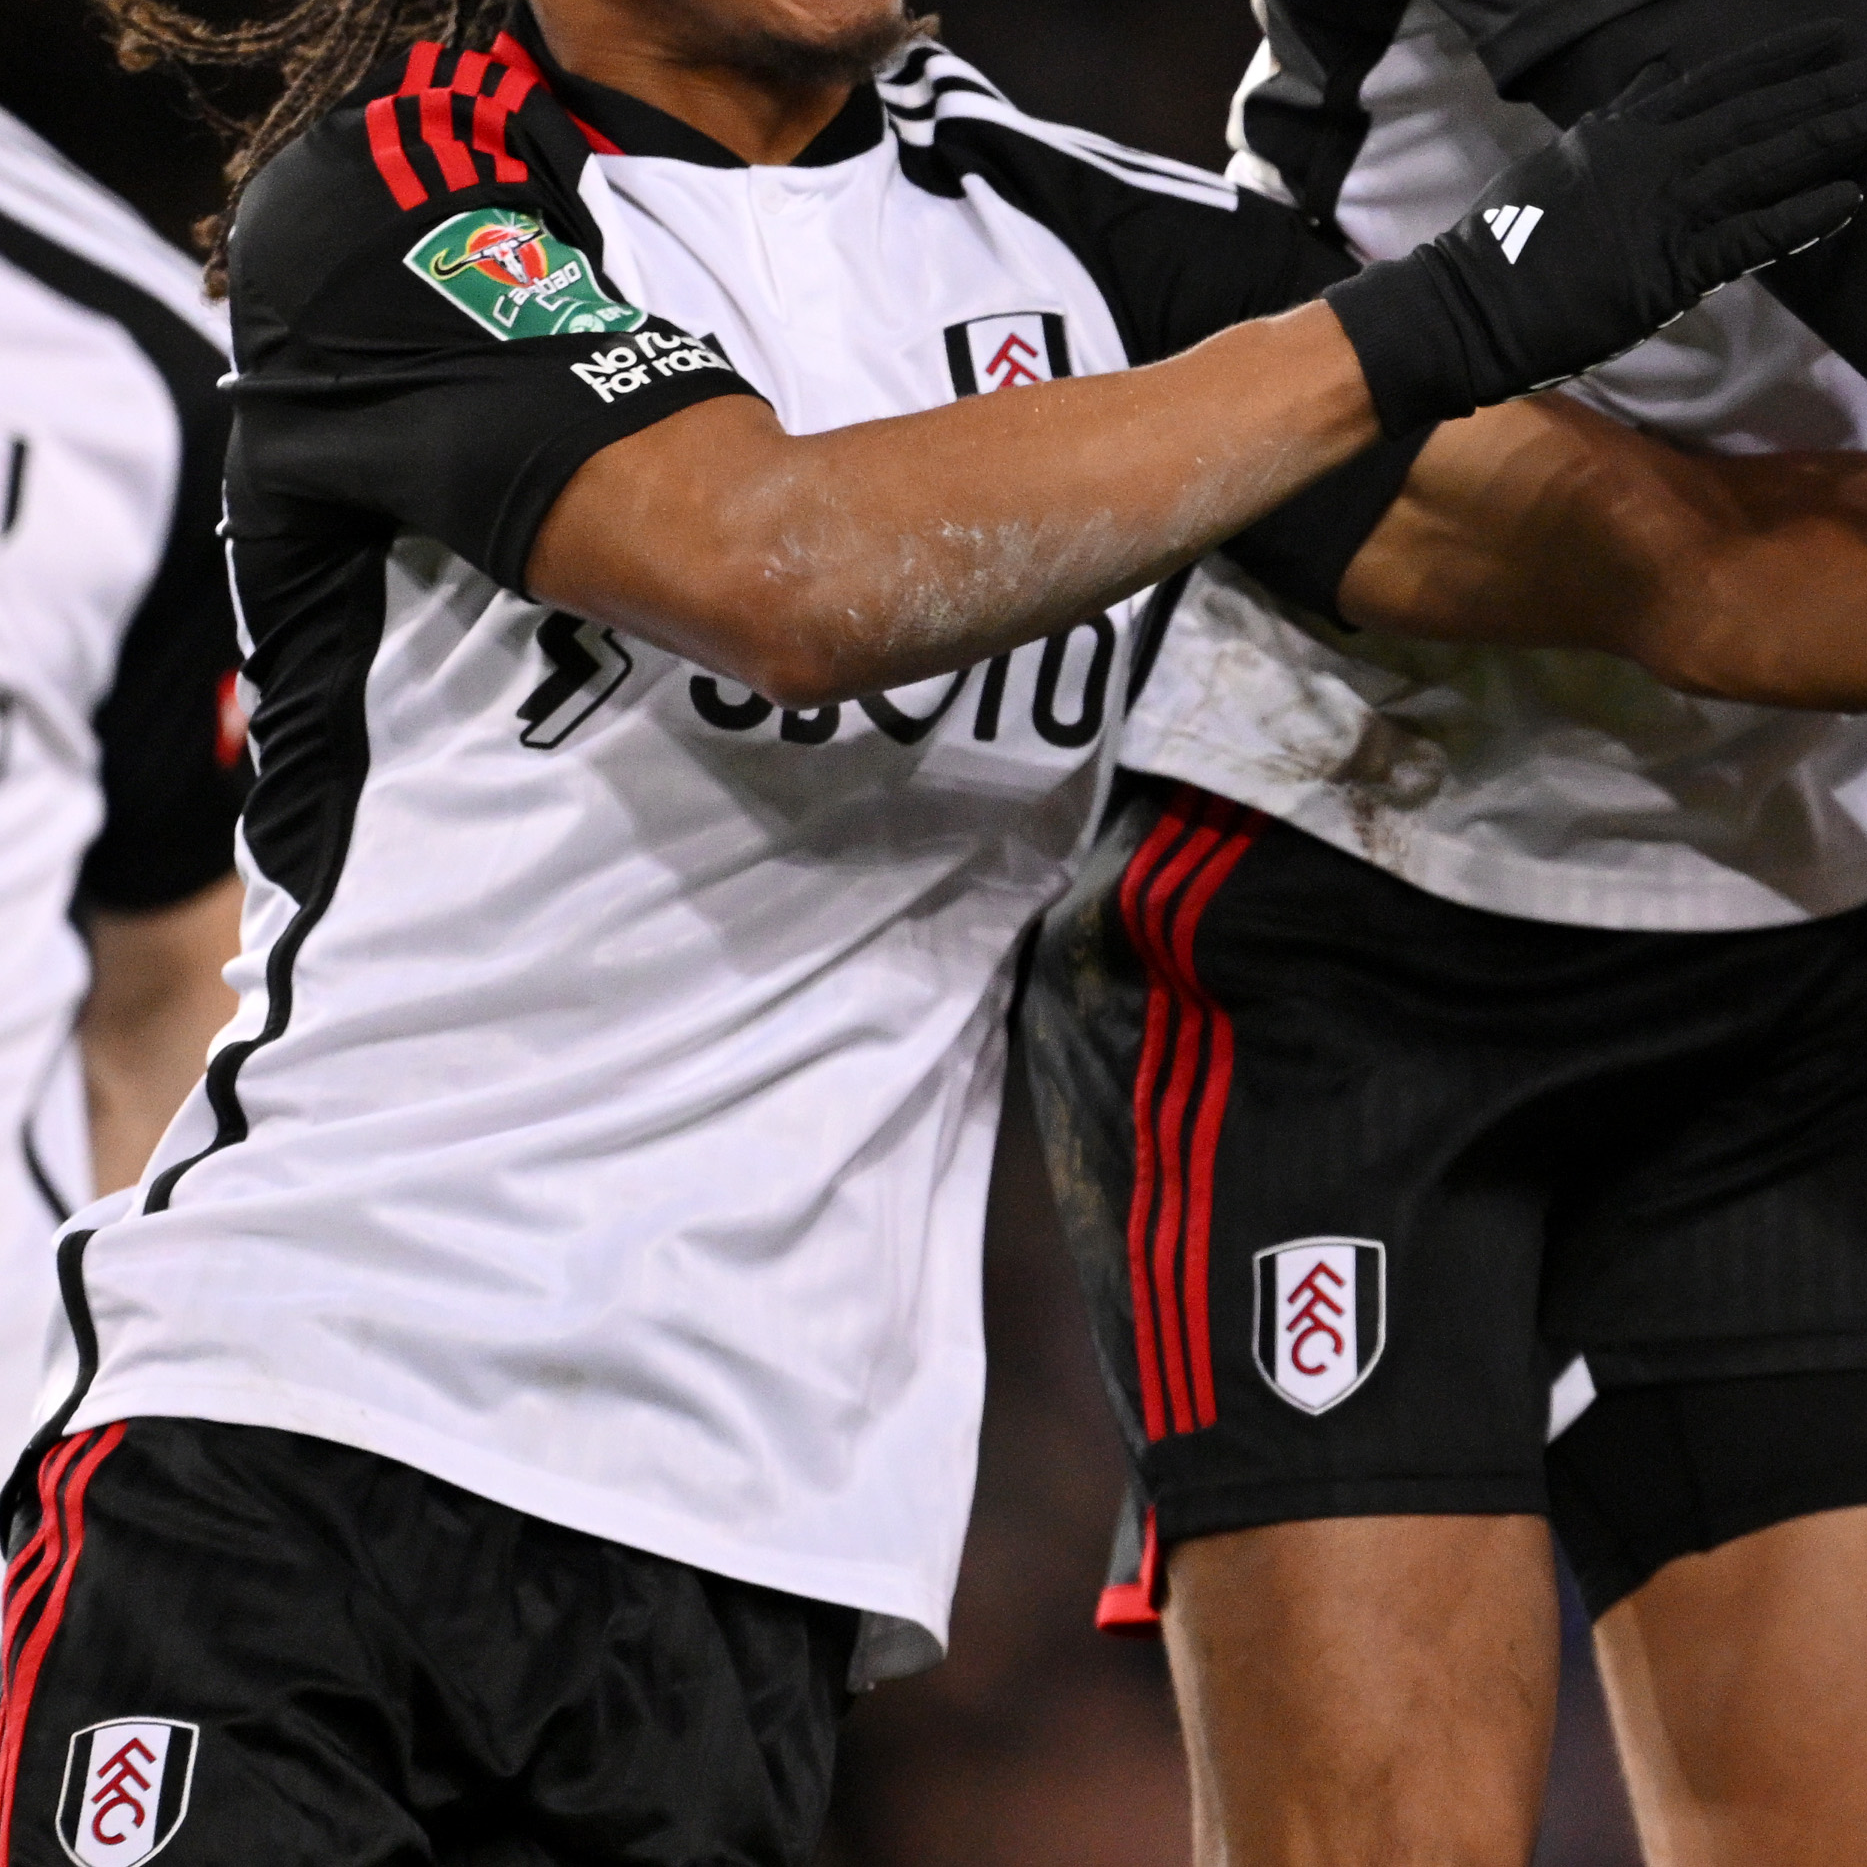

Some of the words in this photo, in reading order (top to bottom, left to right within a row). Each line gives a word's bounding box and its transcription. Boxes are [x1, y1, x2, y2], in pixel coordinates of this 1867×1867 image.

[570, 346, 638, 384] No
[591, 364, 652, 404] for
[985, 332, 1040, 388] FF
[1286, 1261, 1346, 1376] FFC
[91, 1737, 158, 1846] FFC
